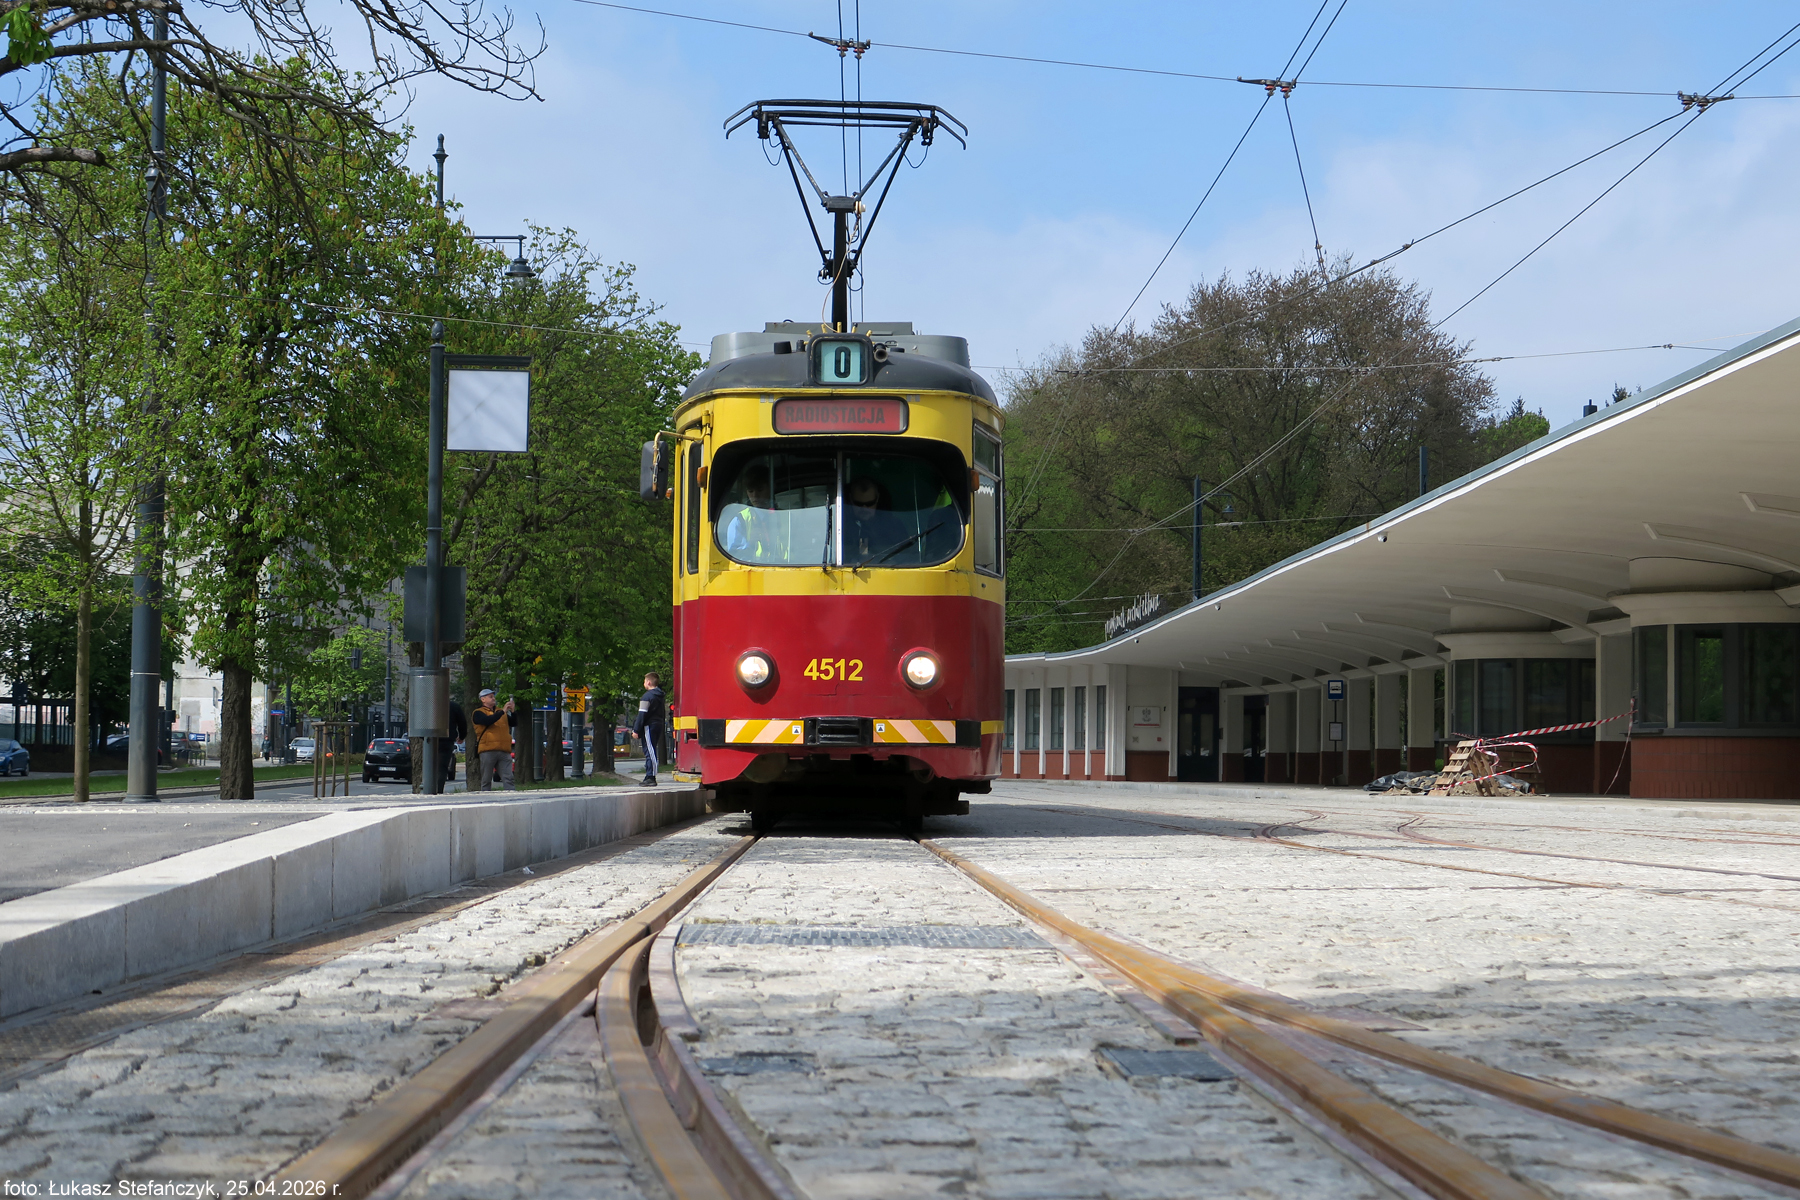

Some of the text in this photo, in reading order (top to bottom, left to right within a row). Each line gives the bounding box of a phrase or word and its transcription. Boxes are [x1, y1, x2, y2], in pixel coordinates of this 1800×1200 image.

[834, 346, 851, 378] 0
[785, 406, 885, 424] RADIOSTACJA
[804, 658, 863, 682] 4512
